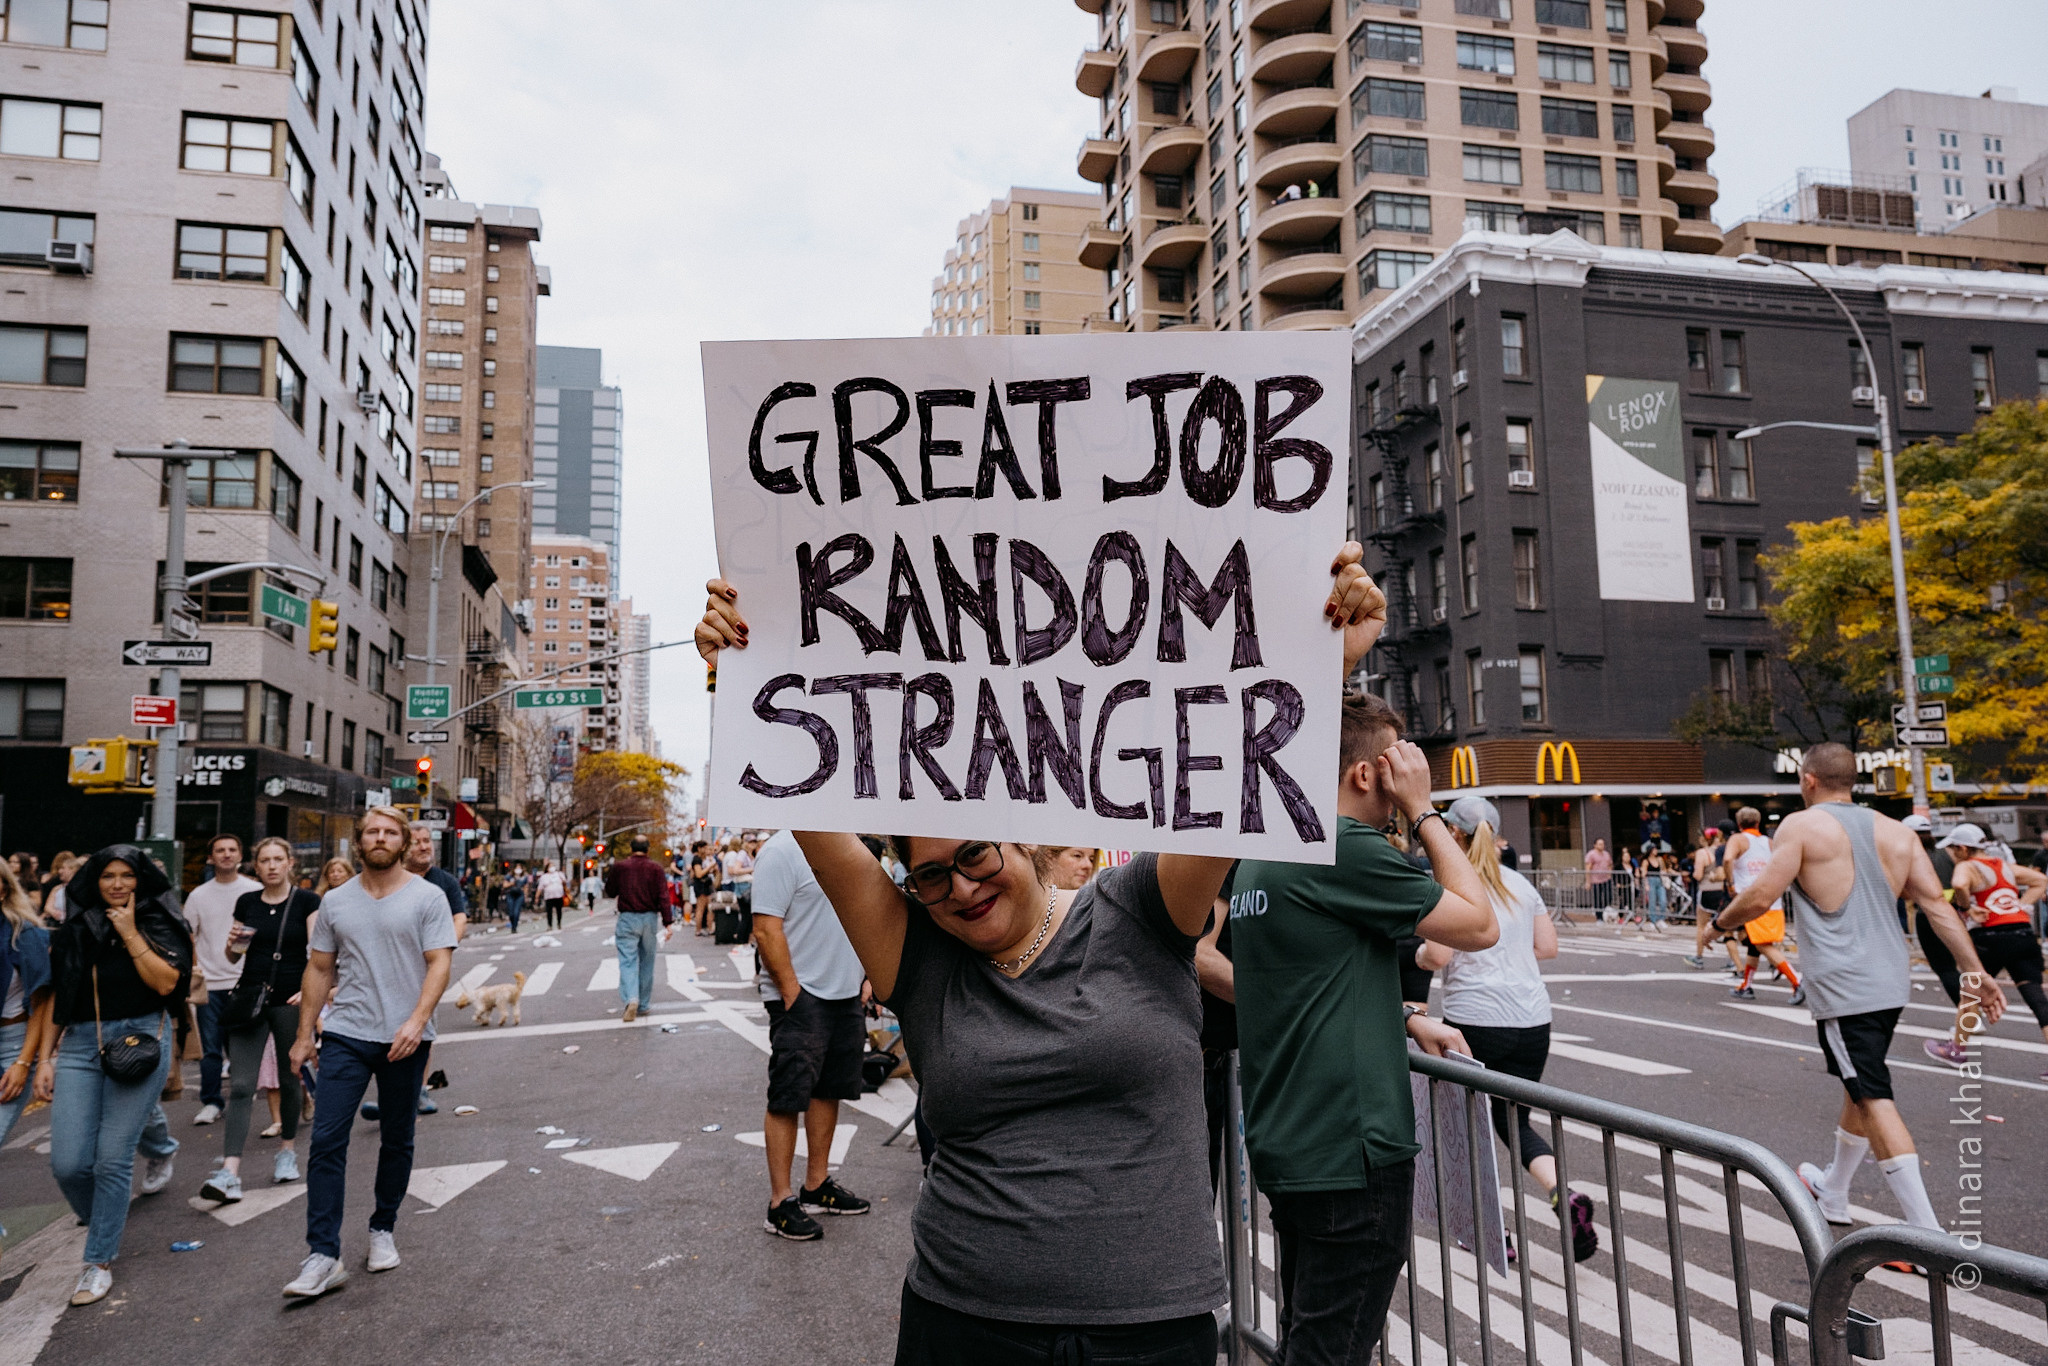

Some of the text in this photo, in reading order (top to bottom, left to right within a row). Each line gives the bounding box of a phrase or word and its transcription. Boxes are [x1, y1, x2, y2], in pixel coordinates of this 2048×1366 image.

[1608, 391, 1666, 420] LENOX
[1620, 410, 1657, 433] ROW
[748, 372, 1334, 514] GREAT JOB
[1599, 483, 1680, 496] NOW LEASING
[796, 531, 1264, 672] RANDOM
[134, 648, 204, 658] ONE WAY
[412, 697, 446, 707] College
[532, 692, 586, 705] E 69 St
[739, 672, 1327, 845] STRANGER
